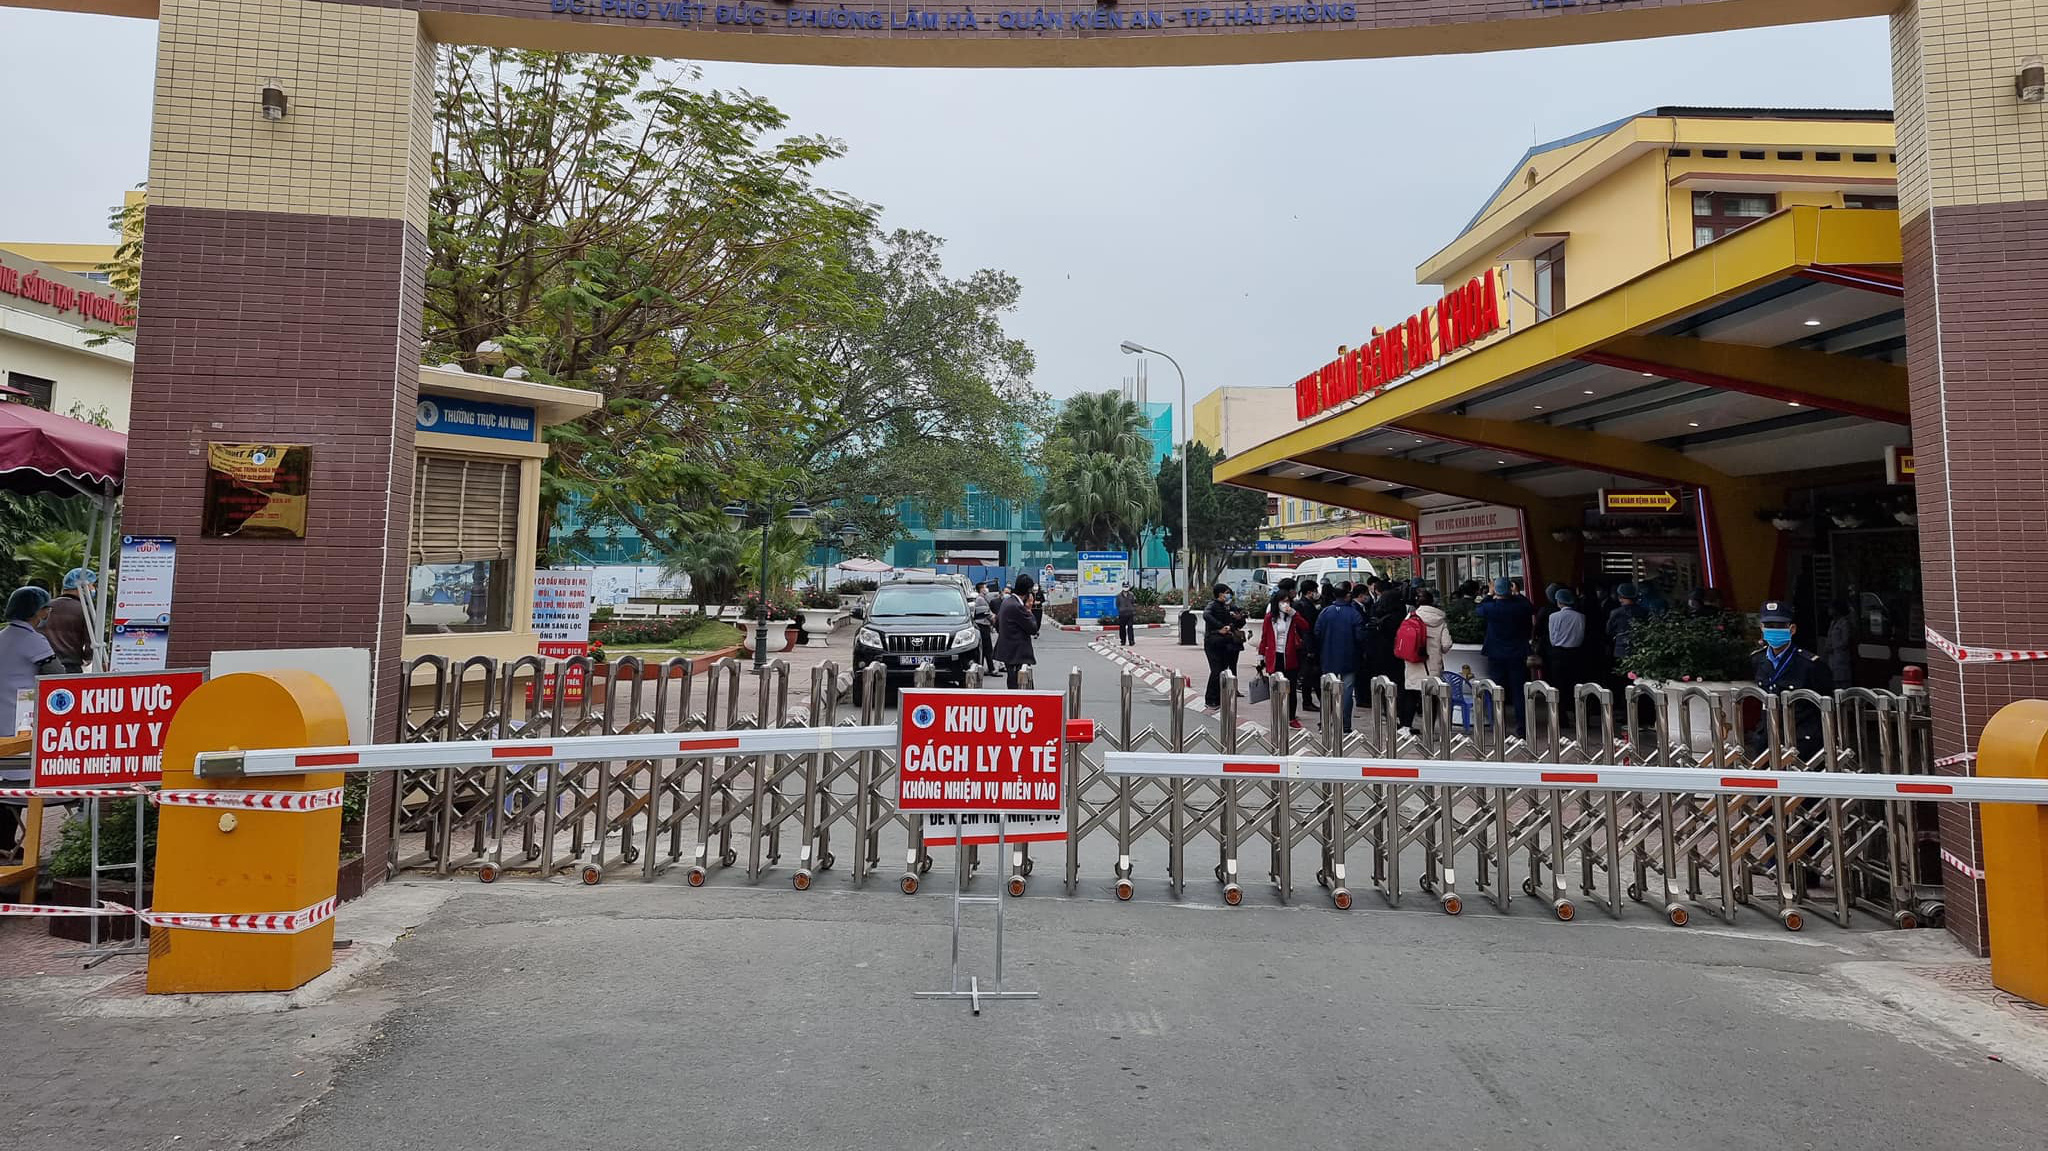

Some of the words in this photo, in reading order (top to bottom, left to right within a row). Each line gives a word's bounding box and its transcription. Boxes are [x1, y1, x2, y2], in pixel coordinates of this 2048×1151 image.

[656, 0, 706, 28] VIỆT
[715, 1, 766, 26] ĐỨC
[786, 4, 883, 29] PHƯỜNG
[948, 5, 978, 30] HÀ
[998, 8, 1063, 37] QUẬN
[1130, 10, 1164, 30] AN
[1224, 2, 1264, 26] HẢI
[1270, 1, 1357, 24] PHÒNG
[22, 269, 54, 306] SÁNG
[1296, 370, 1320, 422] KHU
[1437, 267, 1500, 356] KHOA
[443, 408, 475, 425] THƯỜNG
[476, 413, 497, 430] TRỰC
[498, 415, 509, 429] AN
[510, 417, 529, 431] NINH
[81, 687, 124, 714] KHU
[131, 683, 172, 716] VỰC
[42, 721, 107, 752] CÁCH
[114, 723, 141, 749] LY
[148, 722, 163, 747] Y
[944, 705, 987, 733] KHU
[993, 704, 1034, 739] VỰC
[41, 754, 81, 776] KHÔNG
[83, 752, 121, 777] NHIỆM
[125, 755, 139, 776] VỤ
[142, 749, 163, 773] MIỄ
[904, 739, 969, 772] CÁCH
[976, 745, 1001, 773] LY
[1009, 745, 1023, 773] Y
[1030, 738, 1060, 773] TẾ
[902, 777, 942, 800] KHÔNG
[944, 777, 981, 803] NHIỆM
[985, 781, 999, 804] VỤ
[1002, 775, 1031, 800] MIỄN
[1034, 779, 1056, 801] VÀO
